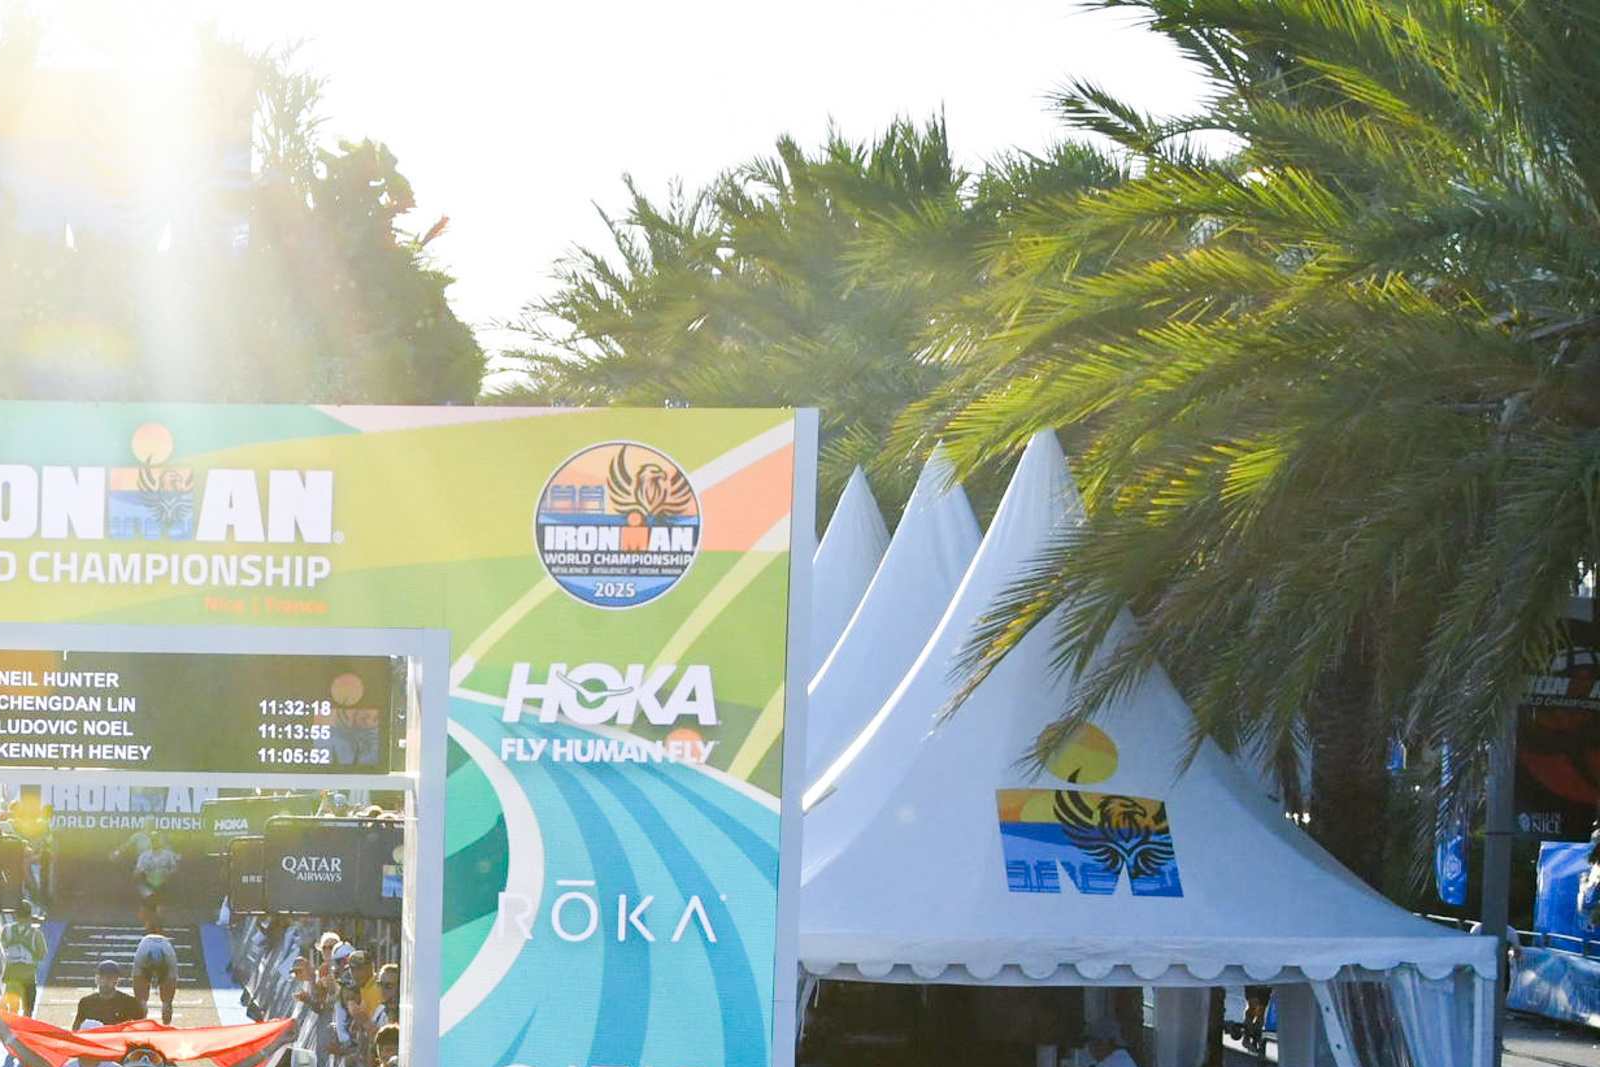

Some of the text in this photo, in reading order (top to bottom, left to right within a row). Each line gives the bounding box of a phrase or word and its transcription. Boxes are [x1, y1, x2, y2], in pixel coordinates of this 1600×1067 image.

[544, 525, 694, 551] IRONMAN
[28, 550, 332, 588] CHAMPIONSHIP
[544, 553, 694, 566] WORLD CHAMPIONSHIP
[594, 582, 636, 598] 2025
[43, 672, 119, 688] HUNTER
[501, 662, 719, 726] HOKA
[107, 697, 136, 713] LIN
[259, 699, 332, 716] 11:32:18
[83, 720, 133, 737] NOEL
[258, 723, 331, 740] 11:13:55
[88, 744, 152, 761] HENEY
[257, 747, 330, 764] 11:05:52
[500, 737, 714, 764] FLY HUMAN FLY
[214, 818, 249, 831] HOKA
[282, 855, 342, 874] QATAR
[297, 872, 342, 882] AIRWAYS
